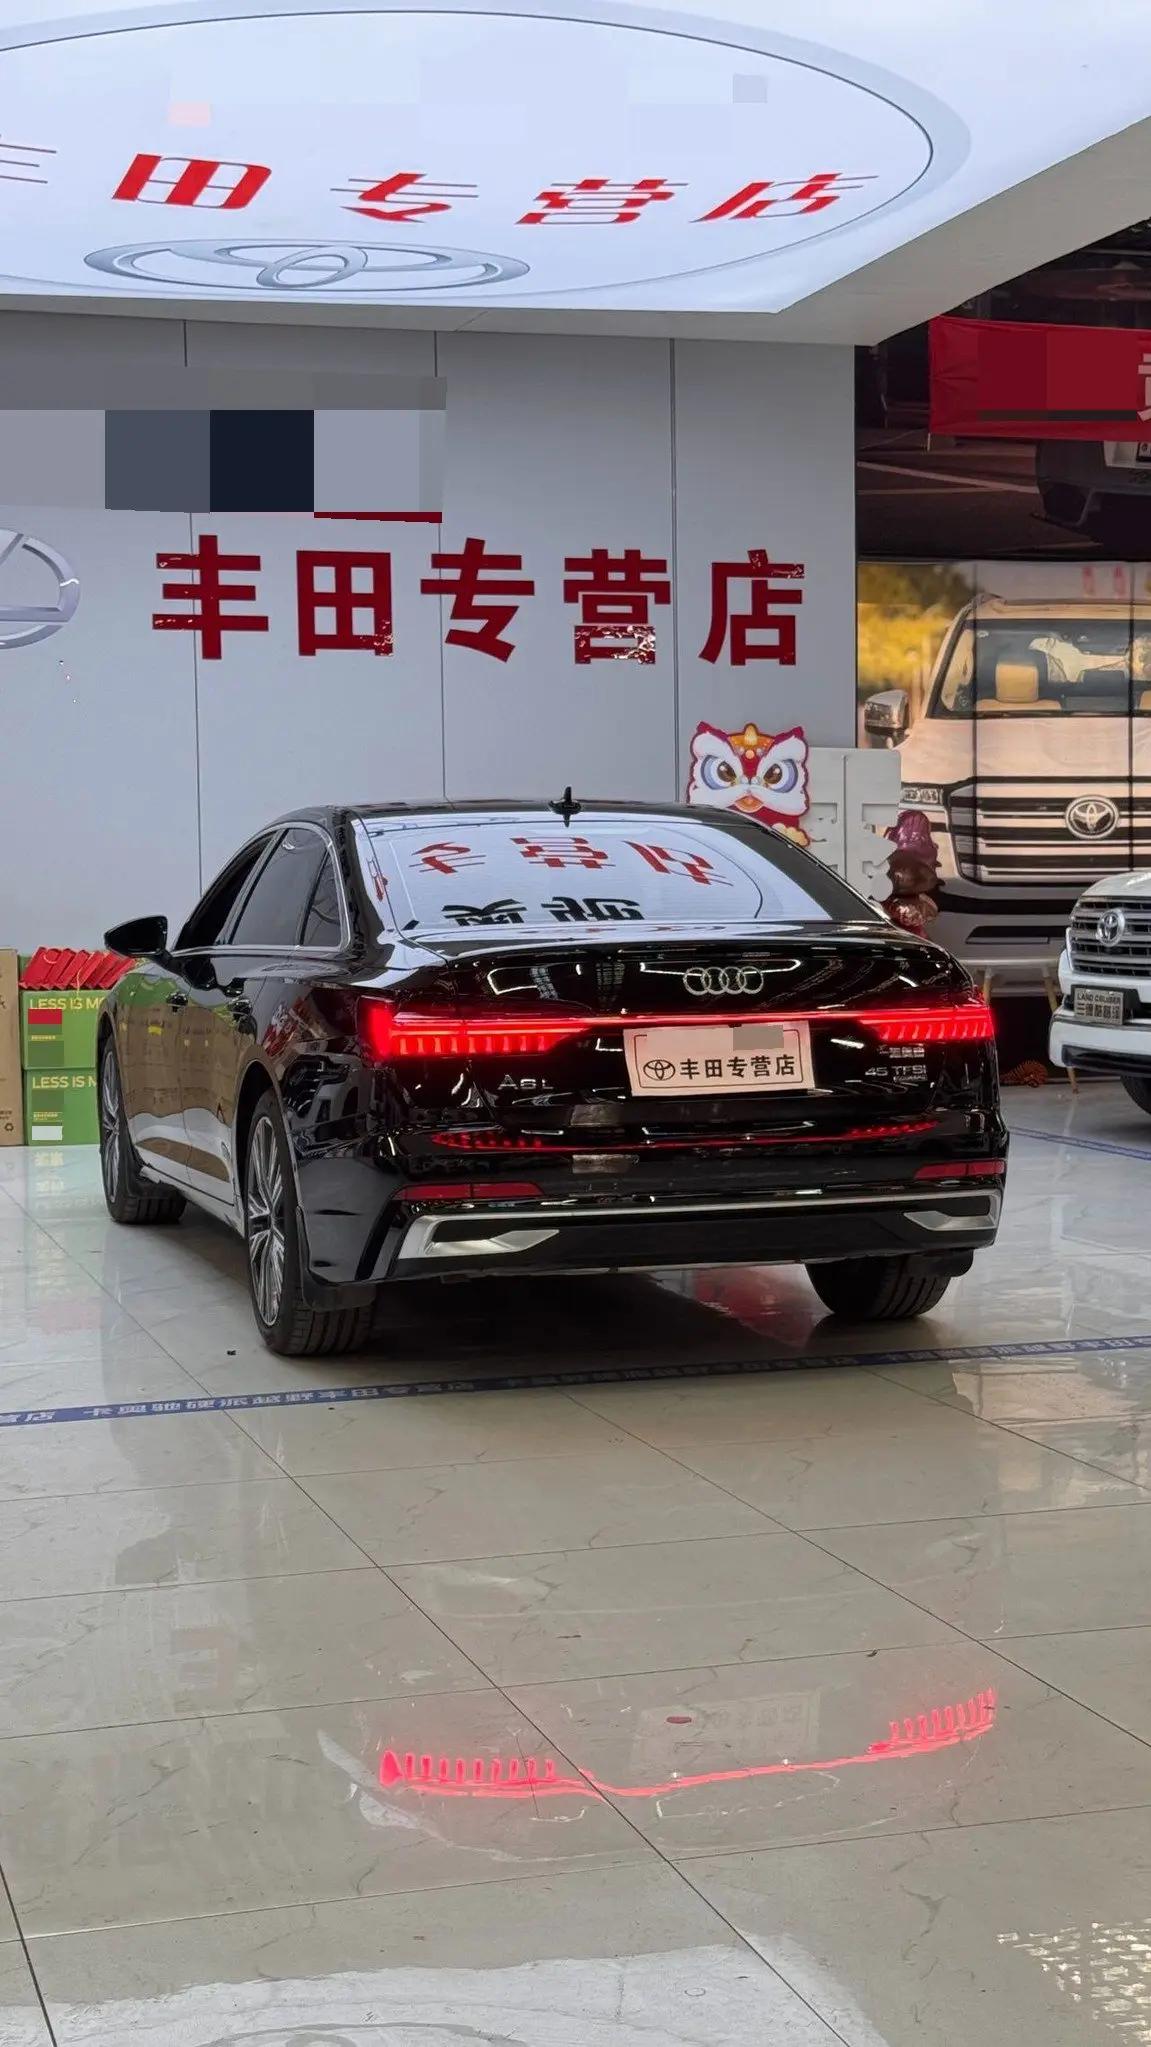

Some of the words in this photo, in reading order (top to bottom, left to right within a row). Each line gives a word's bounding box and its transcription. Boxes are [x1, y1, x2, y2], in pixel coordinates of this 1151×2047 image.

[153, 535, 806, 665] 丰田专营店
[30, 998, 66, 1009] LESS
[680, 1055, 796, 1080] 丰田专营店
[865, 1066, 888, 1077] 45
[32, 1076, 69, 1089] LESS
[72, 1075, 85, 1088] IS
